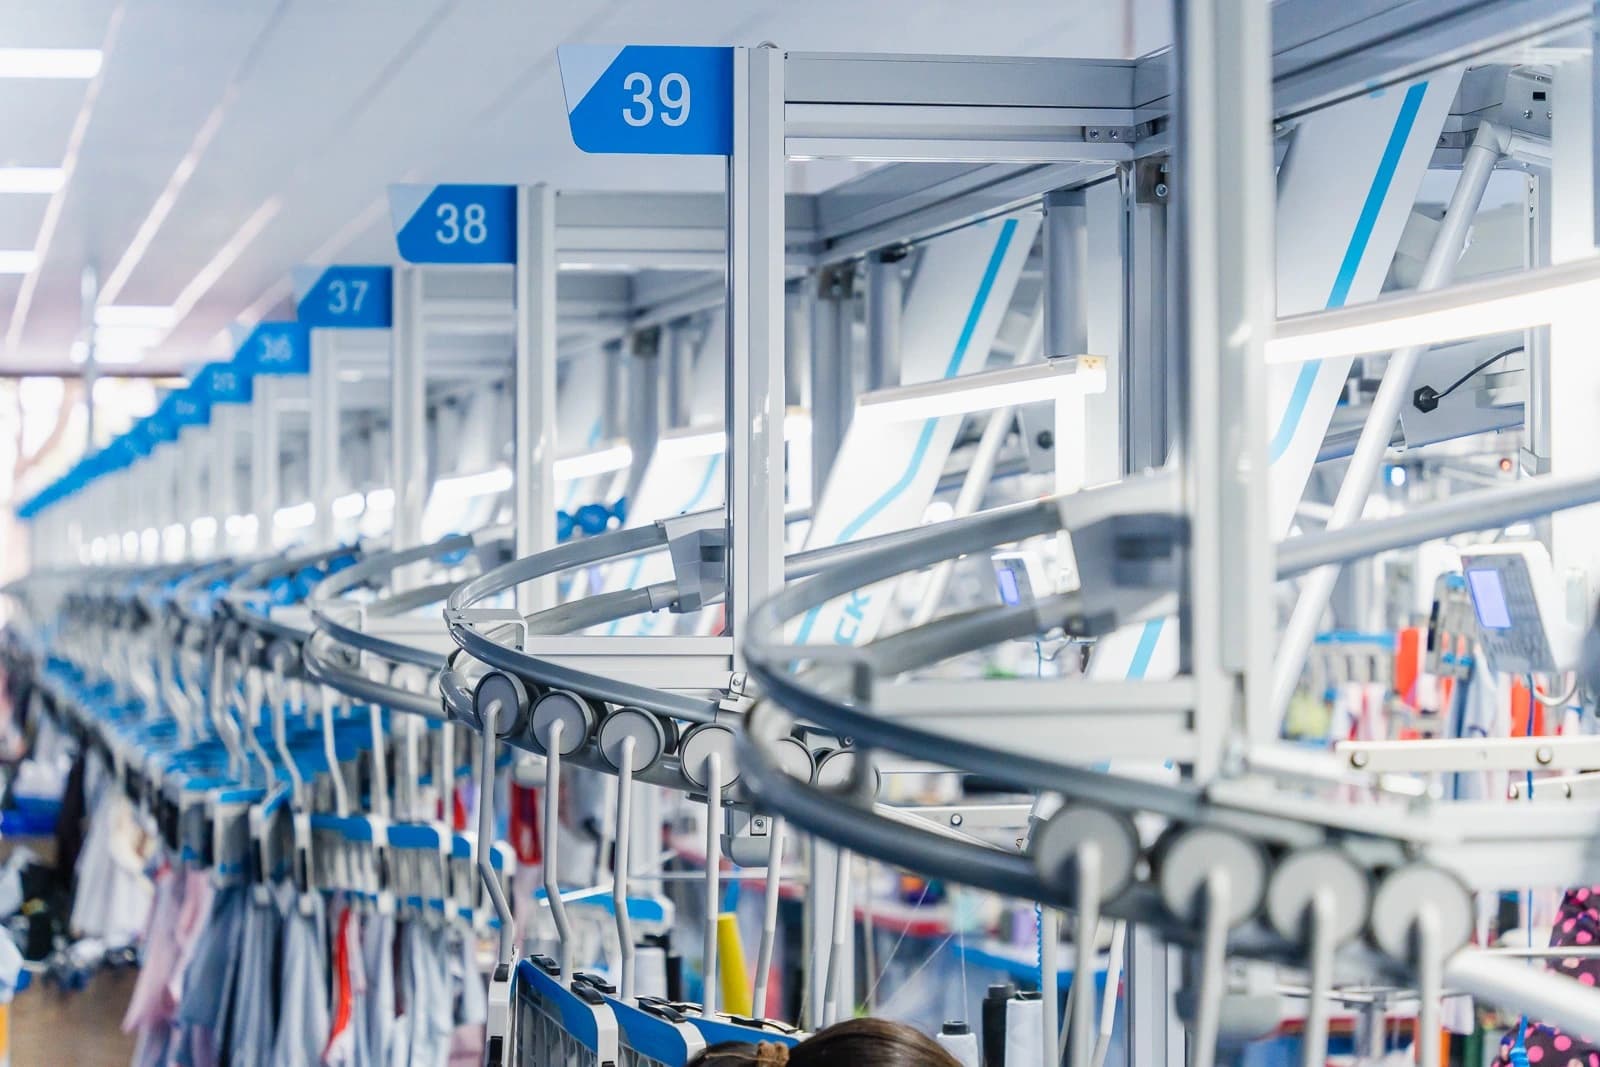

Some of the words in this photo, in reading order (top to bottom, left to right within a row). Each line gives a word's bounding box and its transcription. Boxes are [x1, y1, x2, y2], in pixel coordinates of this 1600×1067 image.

[622, 72, 691, 127] 39
[435, 203, 487, 244] 38
[328, 280, 369, 313] 37
